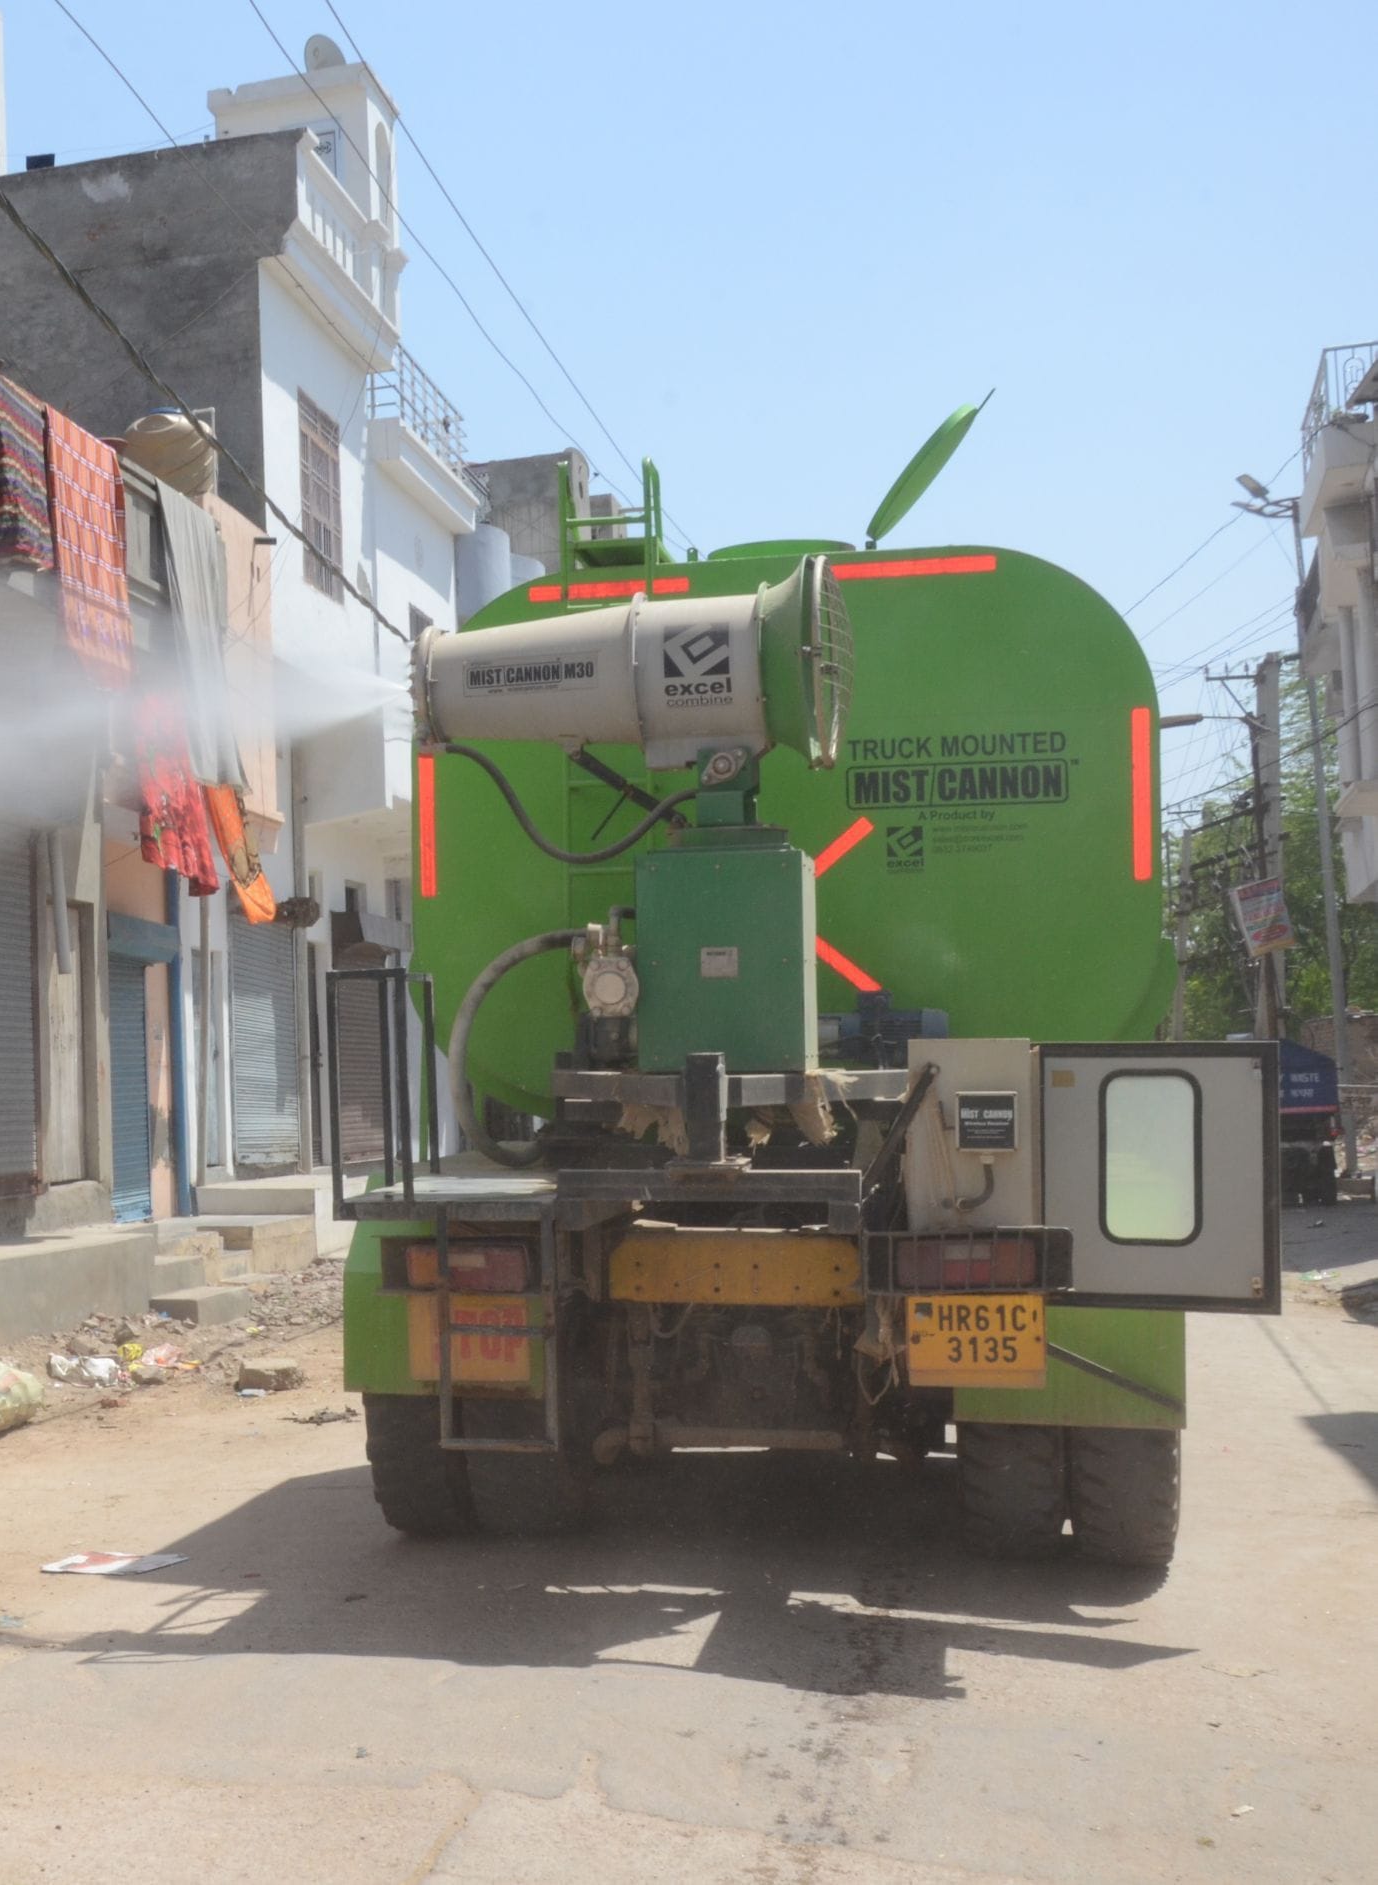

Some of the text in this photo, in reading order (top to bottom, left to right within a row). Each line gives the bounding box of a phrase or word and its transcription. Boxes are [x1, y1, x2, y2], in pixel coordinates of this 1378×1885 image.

[469, 662, 594, 686] MIST CANNON M30
[664, 677, 732, 696] excel
[666, 695, 733, 708] combine
[848, 731, 1066, 761] TRUCK MOUNTED
[854, 764, 1062, 804] MIST CANNON
[918, 809, 996, 822] A Product by
[887, 858, 925, 868] excel
[937, 1304, 1027, 1331] HR61C
[947, 1336, 1018, 1363] 3135
